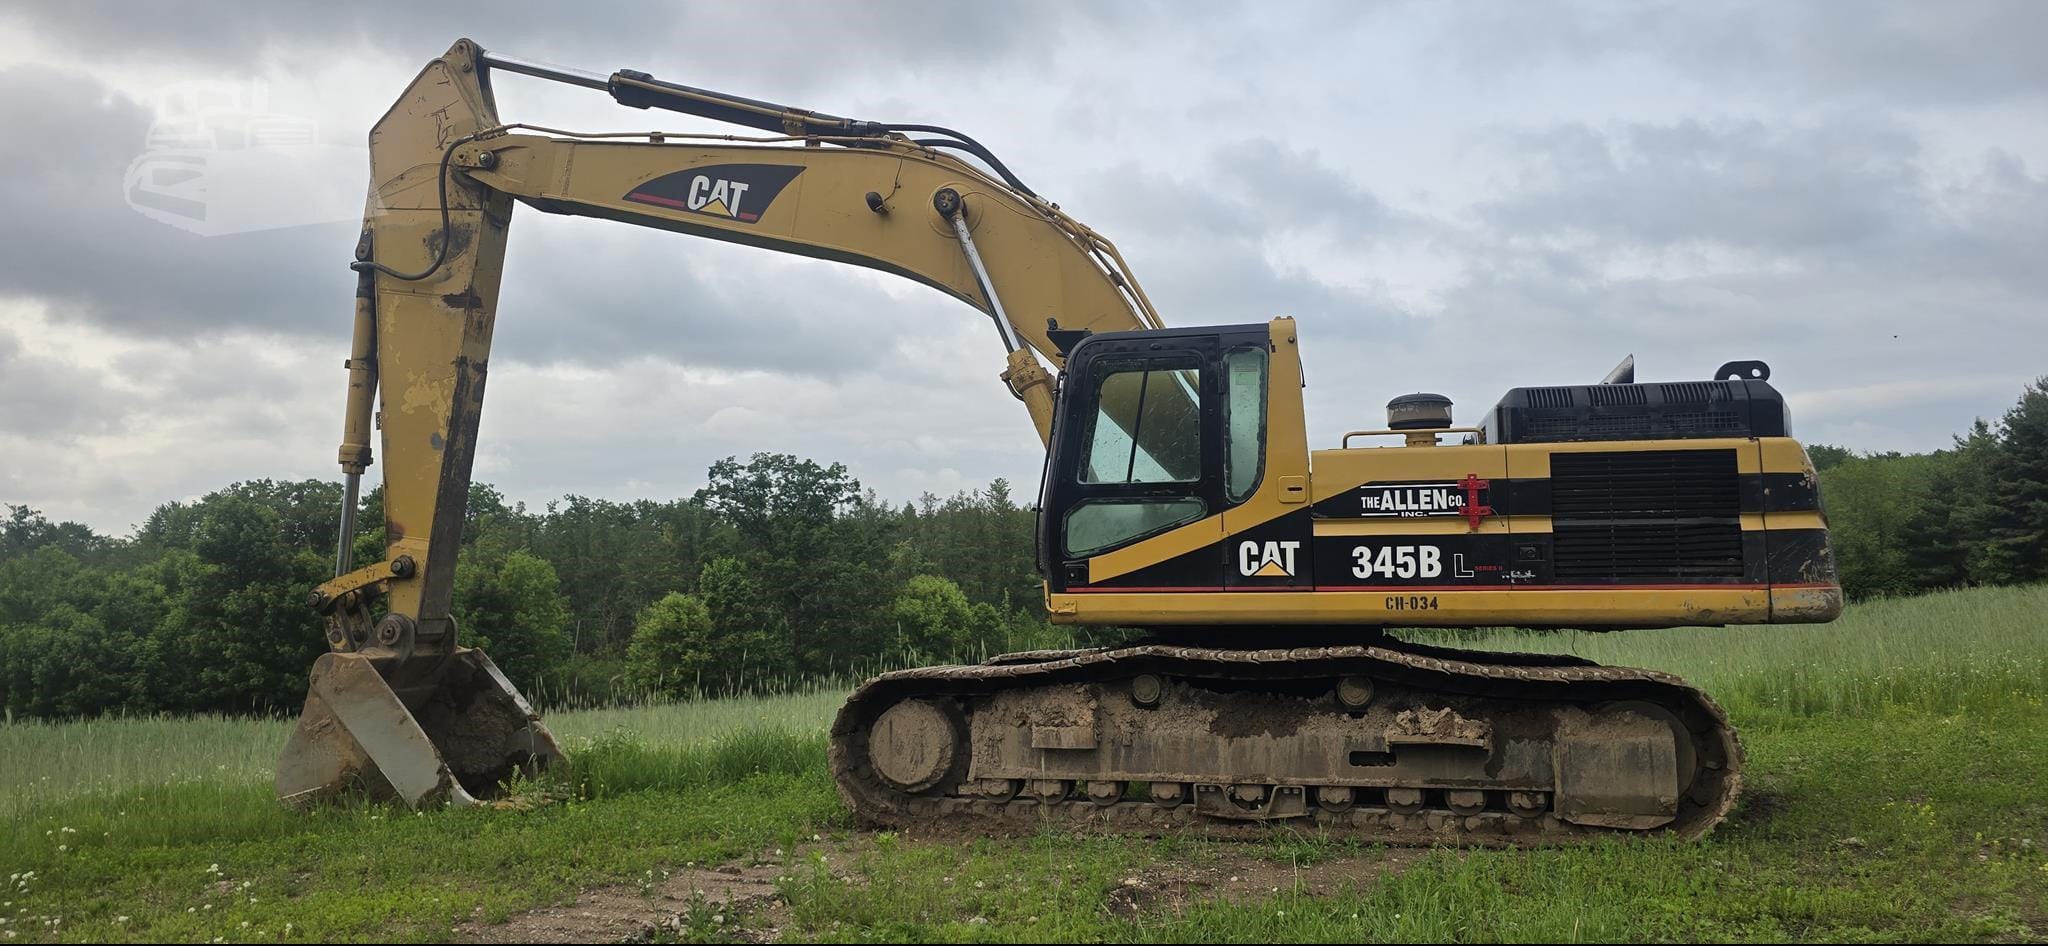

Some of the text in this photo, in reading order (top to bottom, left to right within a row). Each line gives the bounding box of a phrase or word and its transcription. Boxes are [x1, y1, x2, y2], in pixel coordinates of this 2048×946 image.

[687, 175, 749, 217] CAT
[1361, 489, 1466, 510] THE ALLEN CO.
[1239, 541, 1300, 576] CAT
[1352, 545, 1442, 579] 345B
[1454, 554, 1474, 578] L
[1386, 596, 1438, 610] CH-034
